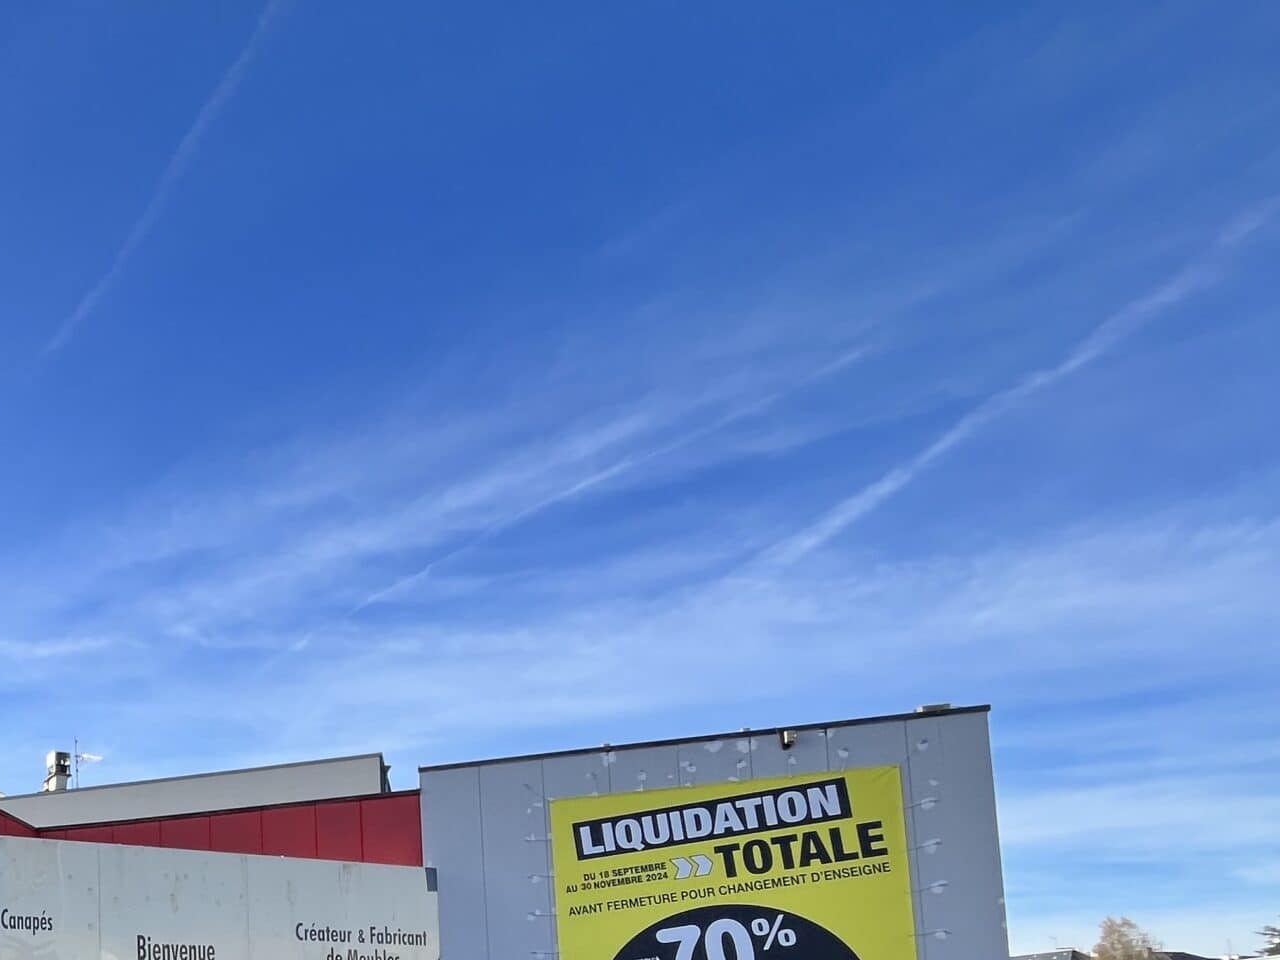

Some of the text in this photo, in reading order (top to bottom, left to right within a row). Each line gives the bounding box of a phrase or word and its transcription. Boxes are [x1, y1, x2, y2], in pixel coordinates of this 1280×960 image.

[579, 783, 842, 856] LIQUIDATION
[714, 821, 889, 878] TOTALE
[566, 871, 669, 893] AU 30 NOVEMBRE 2024
[583, 862, 667, 881] DU 18 SEPTEMBRE
[568, 862, 892, 917] AVANT FERMETURE POUR CHANGEMENT D'ENSEIGNE
[1, 908, 54, 935] Canapés
[295, 922, 428, 947] Créateur & Fabricant
